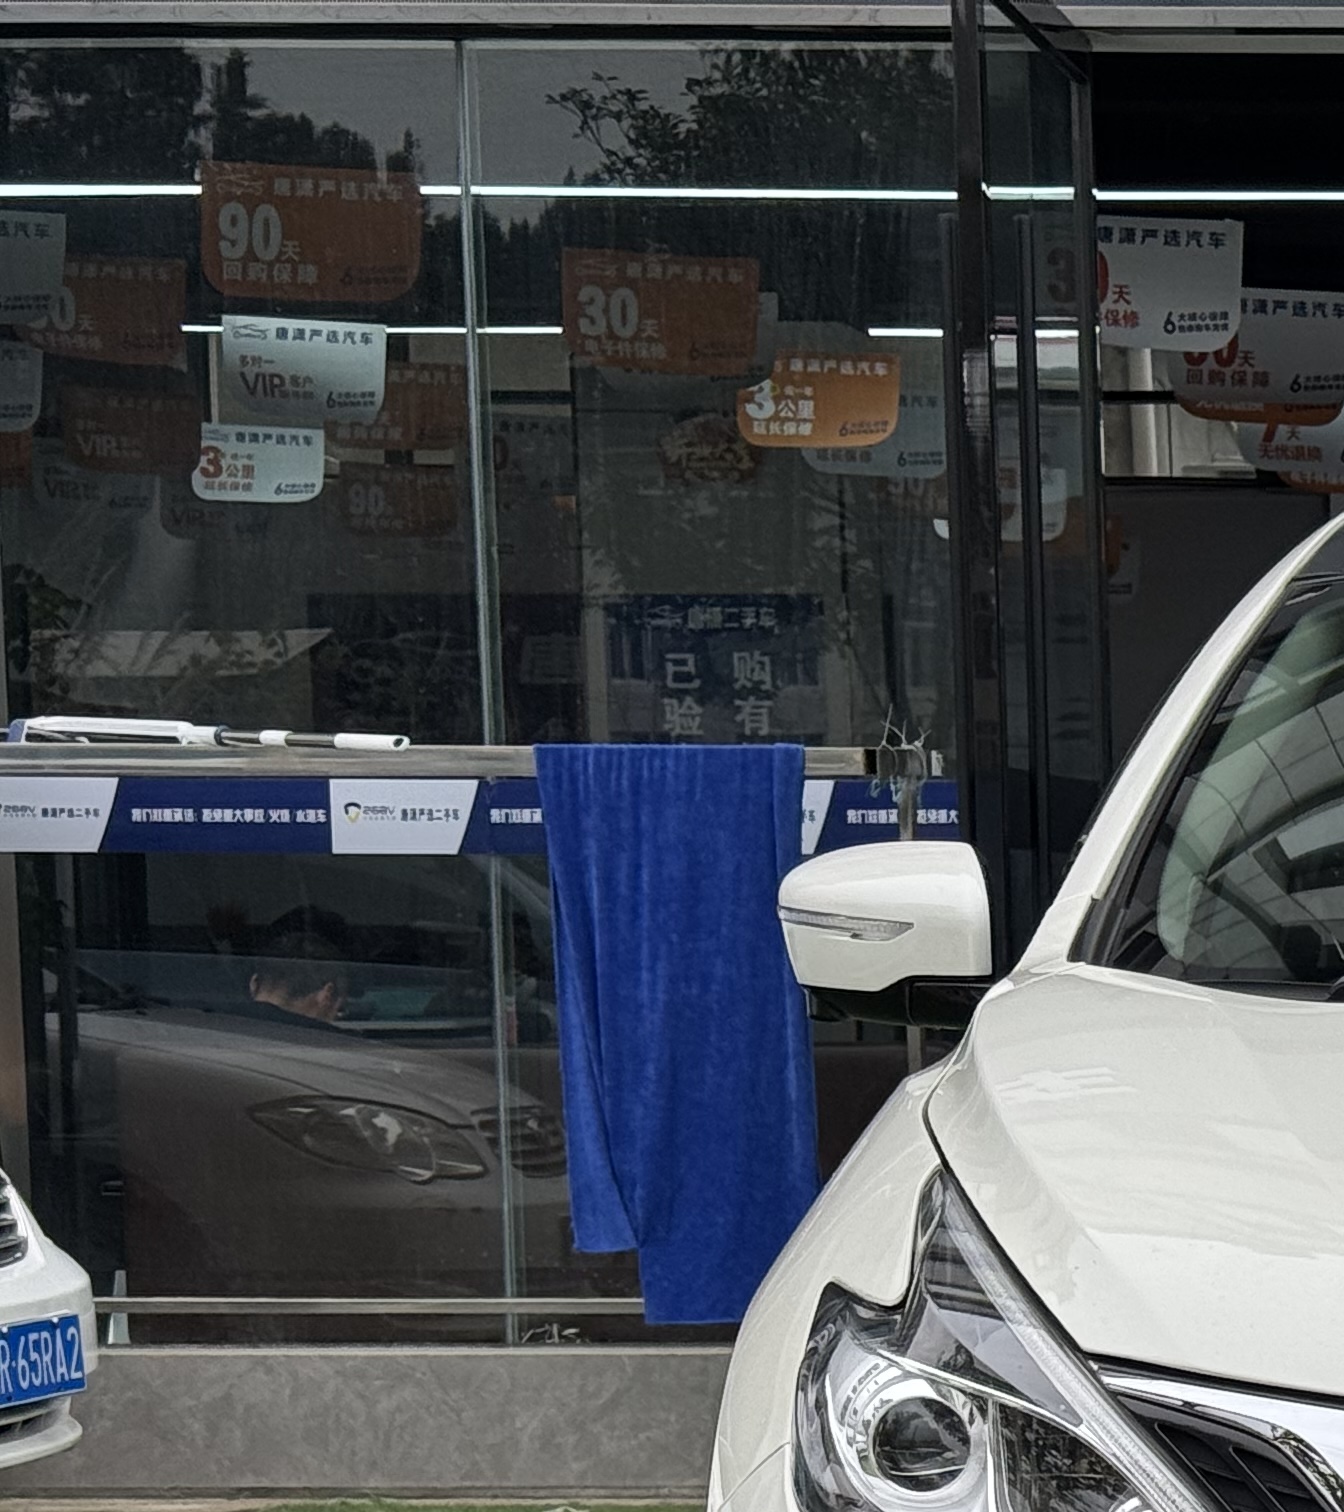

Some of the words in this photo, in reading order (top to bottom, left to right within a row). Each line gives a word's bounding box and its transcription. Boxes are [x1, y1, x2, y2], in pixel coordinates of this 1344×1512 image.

[223, 261, 317, 284] 回购保障
[1163, 311, 1176, 335] 6
[240, 372, 286, 399] VIP
[1186, 369, 1271, 389] 回购保障
[1289, 374, 1301, 394] 6
[778, 400, 816, 420] 公里
[200, 446, 223, 478] 3
[225, 463, 256, 480] 公里
